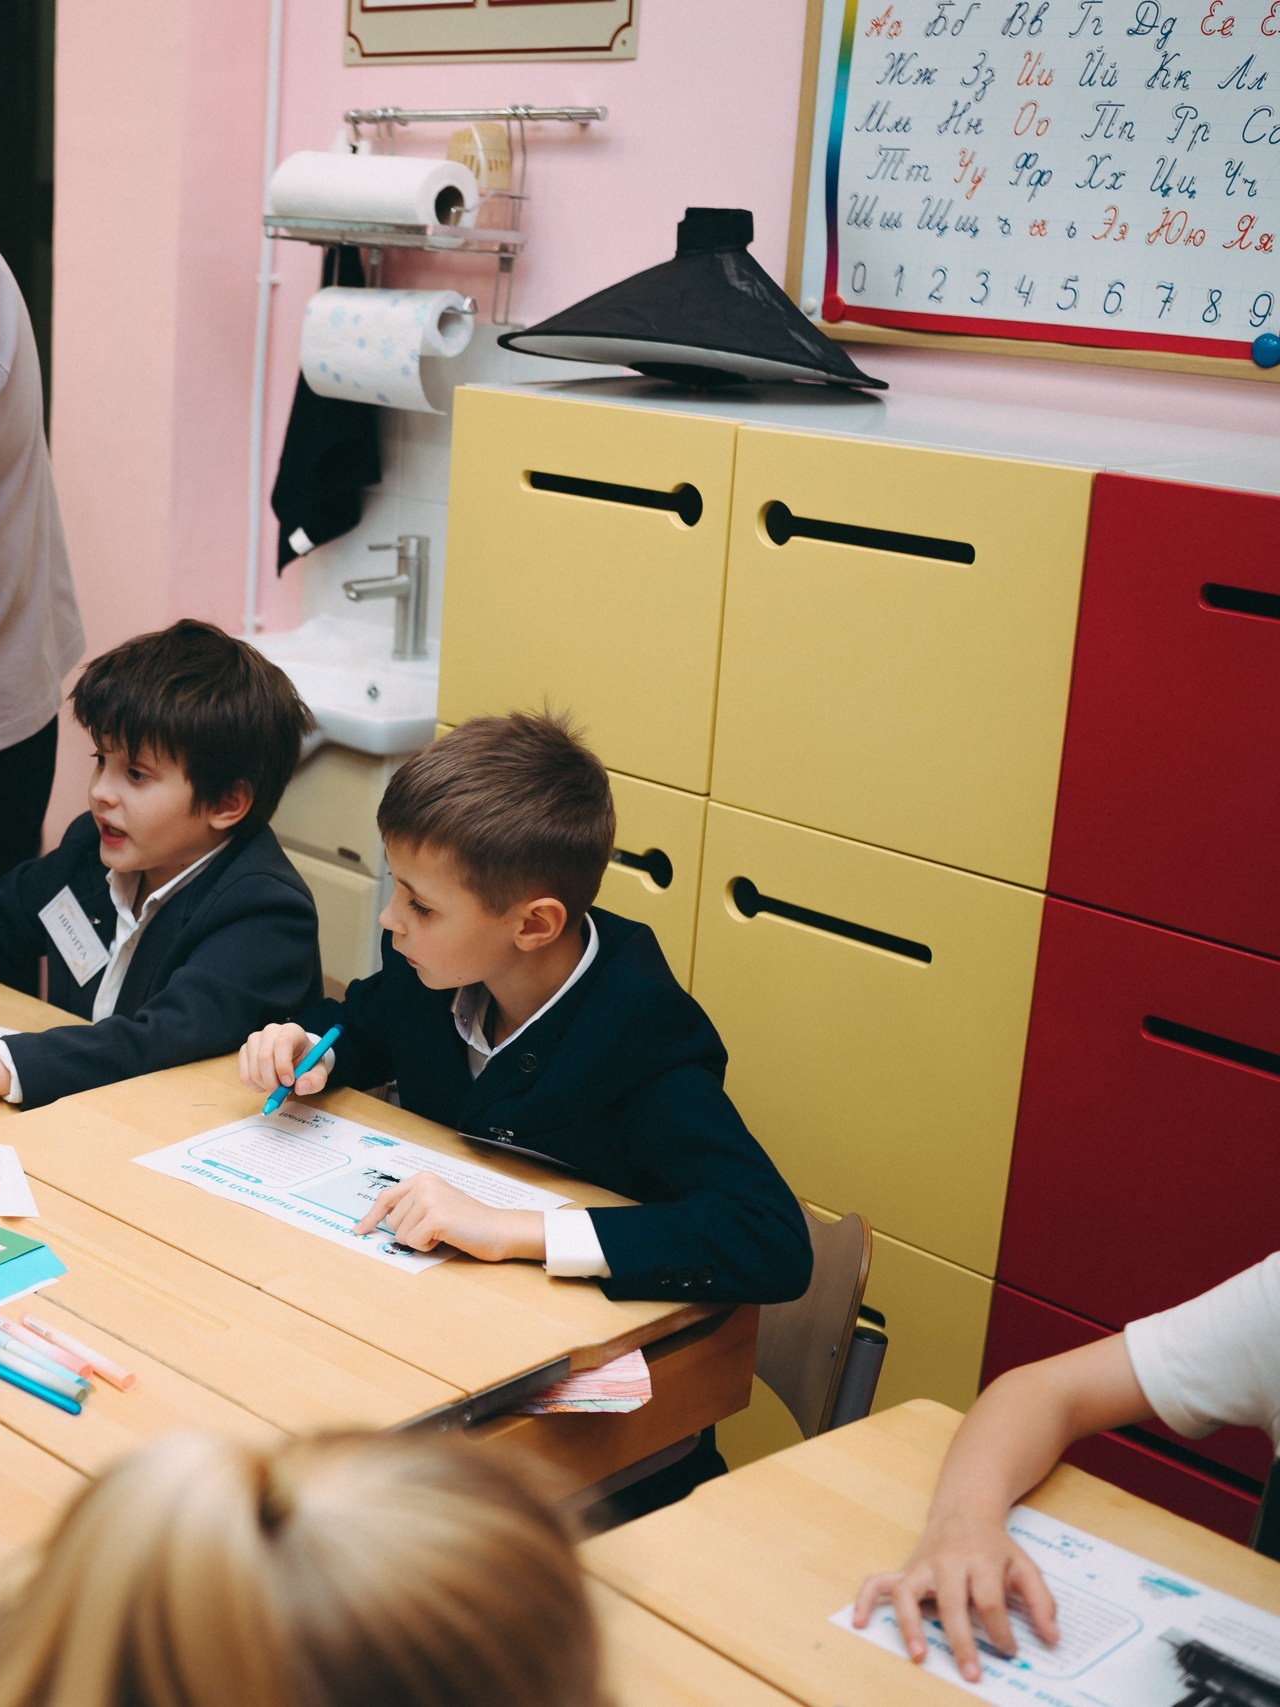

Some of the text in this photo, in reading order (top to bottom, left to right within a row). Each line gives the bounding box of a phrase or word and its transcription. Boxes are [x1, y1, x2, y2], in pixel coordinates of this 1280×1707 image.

[894, 264, 905, 297] 1
[928, 267, 948, 302] 2
[970, 270, 990, 304] 3
[1016, 274, 1034, 307] 4
[1056, 277, 1079, 310] 5
[1103, 281, 1125, 315] 6
[1156, 283, 1175, 319] 7
[1202, 289, 1222, 323] 8
[1249, 293, 1272, 327] 9
[58, 913, 88, 960] НИКИТА
[180, 1164, 229, 1184] ЛИДЕР
